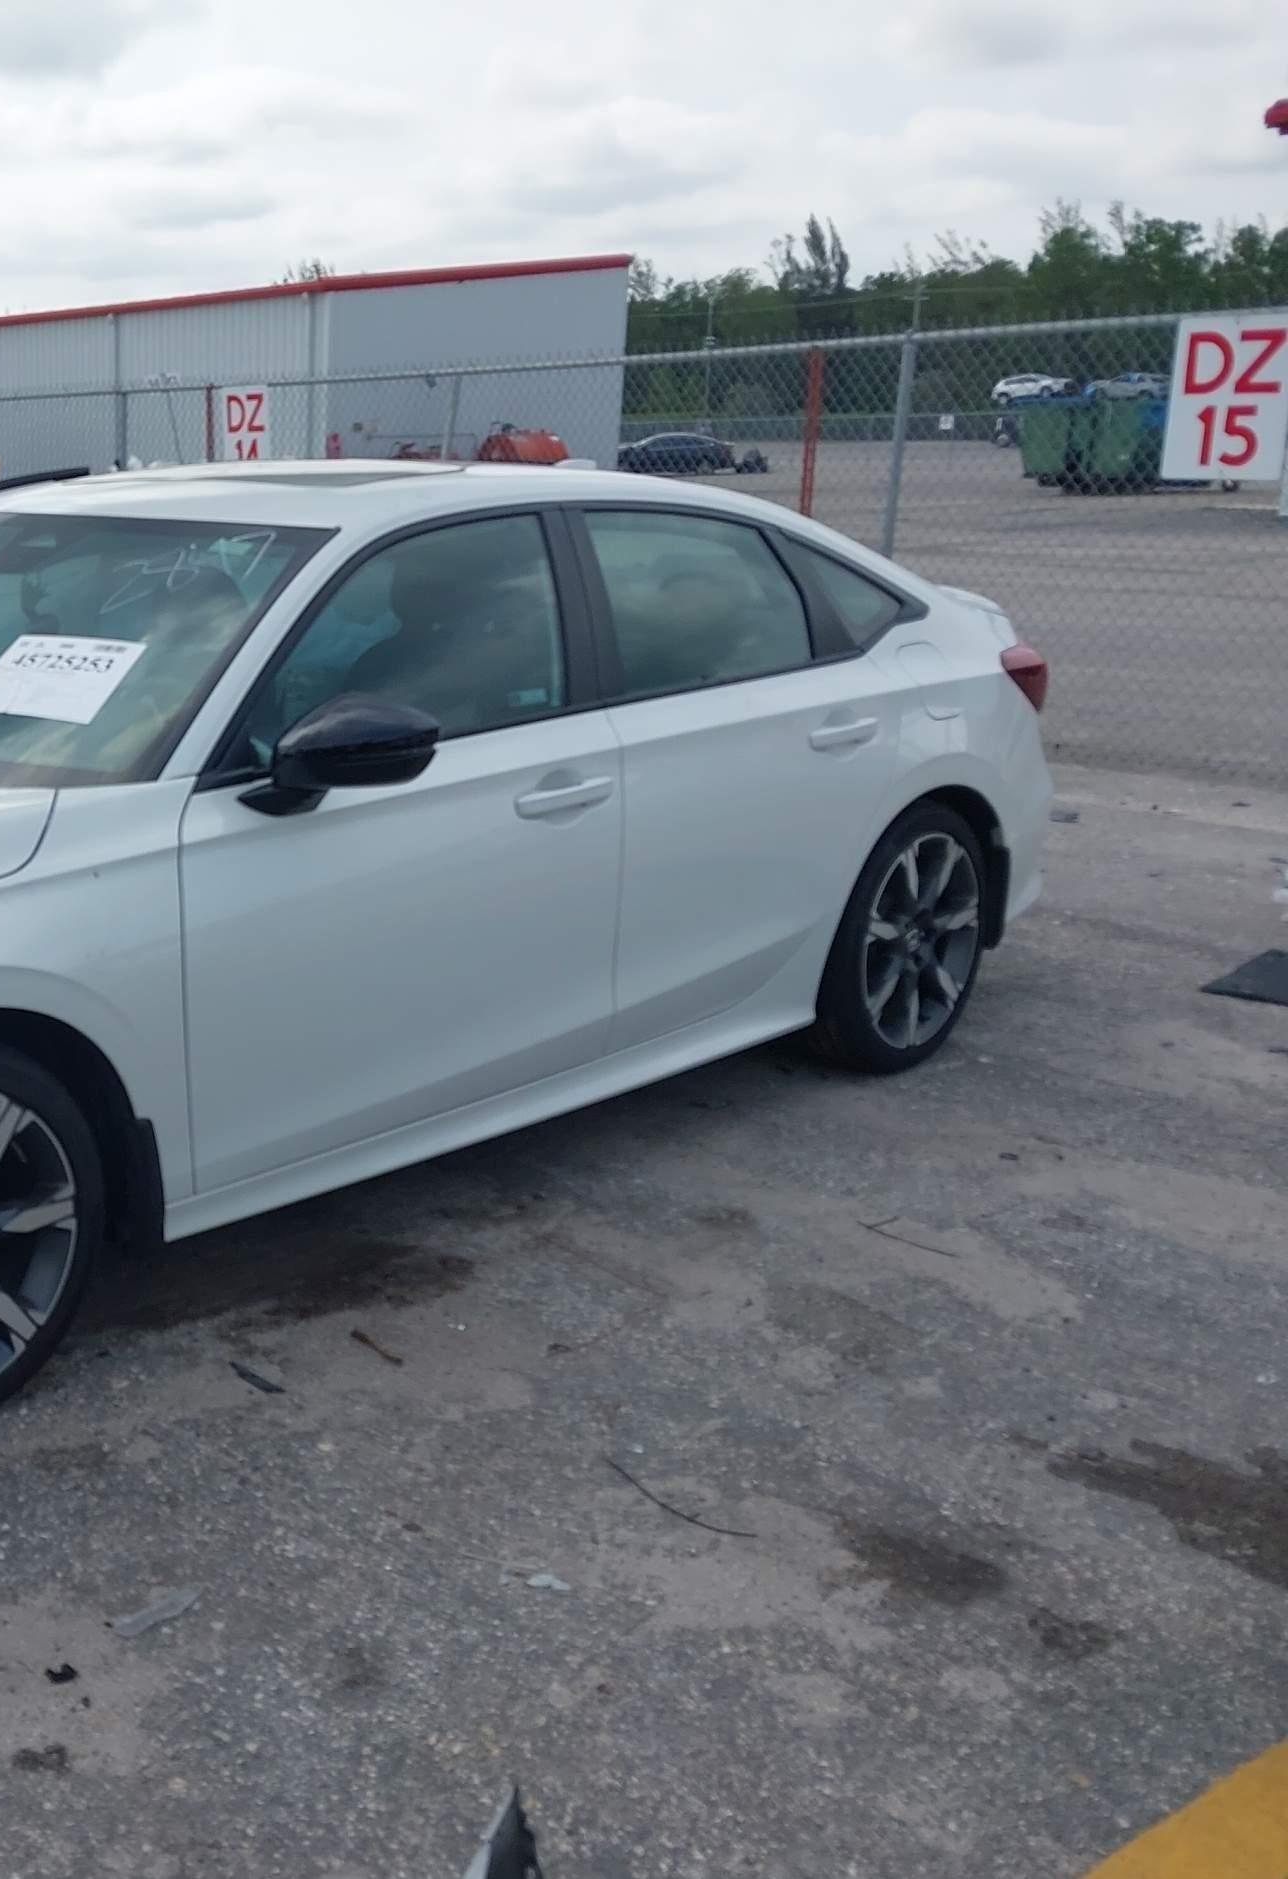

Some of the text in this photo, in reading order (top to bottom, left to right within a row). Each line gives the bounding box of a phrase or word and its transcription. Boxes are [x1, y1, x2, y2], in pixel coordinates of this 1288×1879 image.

[1184, 329, 1287, 394] DZ
[227, 393, 265, 433] DZ
[1197, 405, 1258, 466] 15
